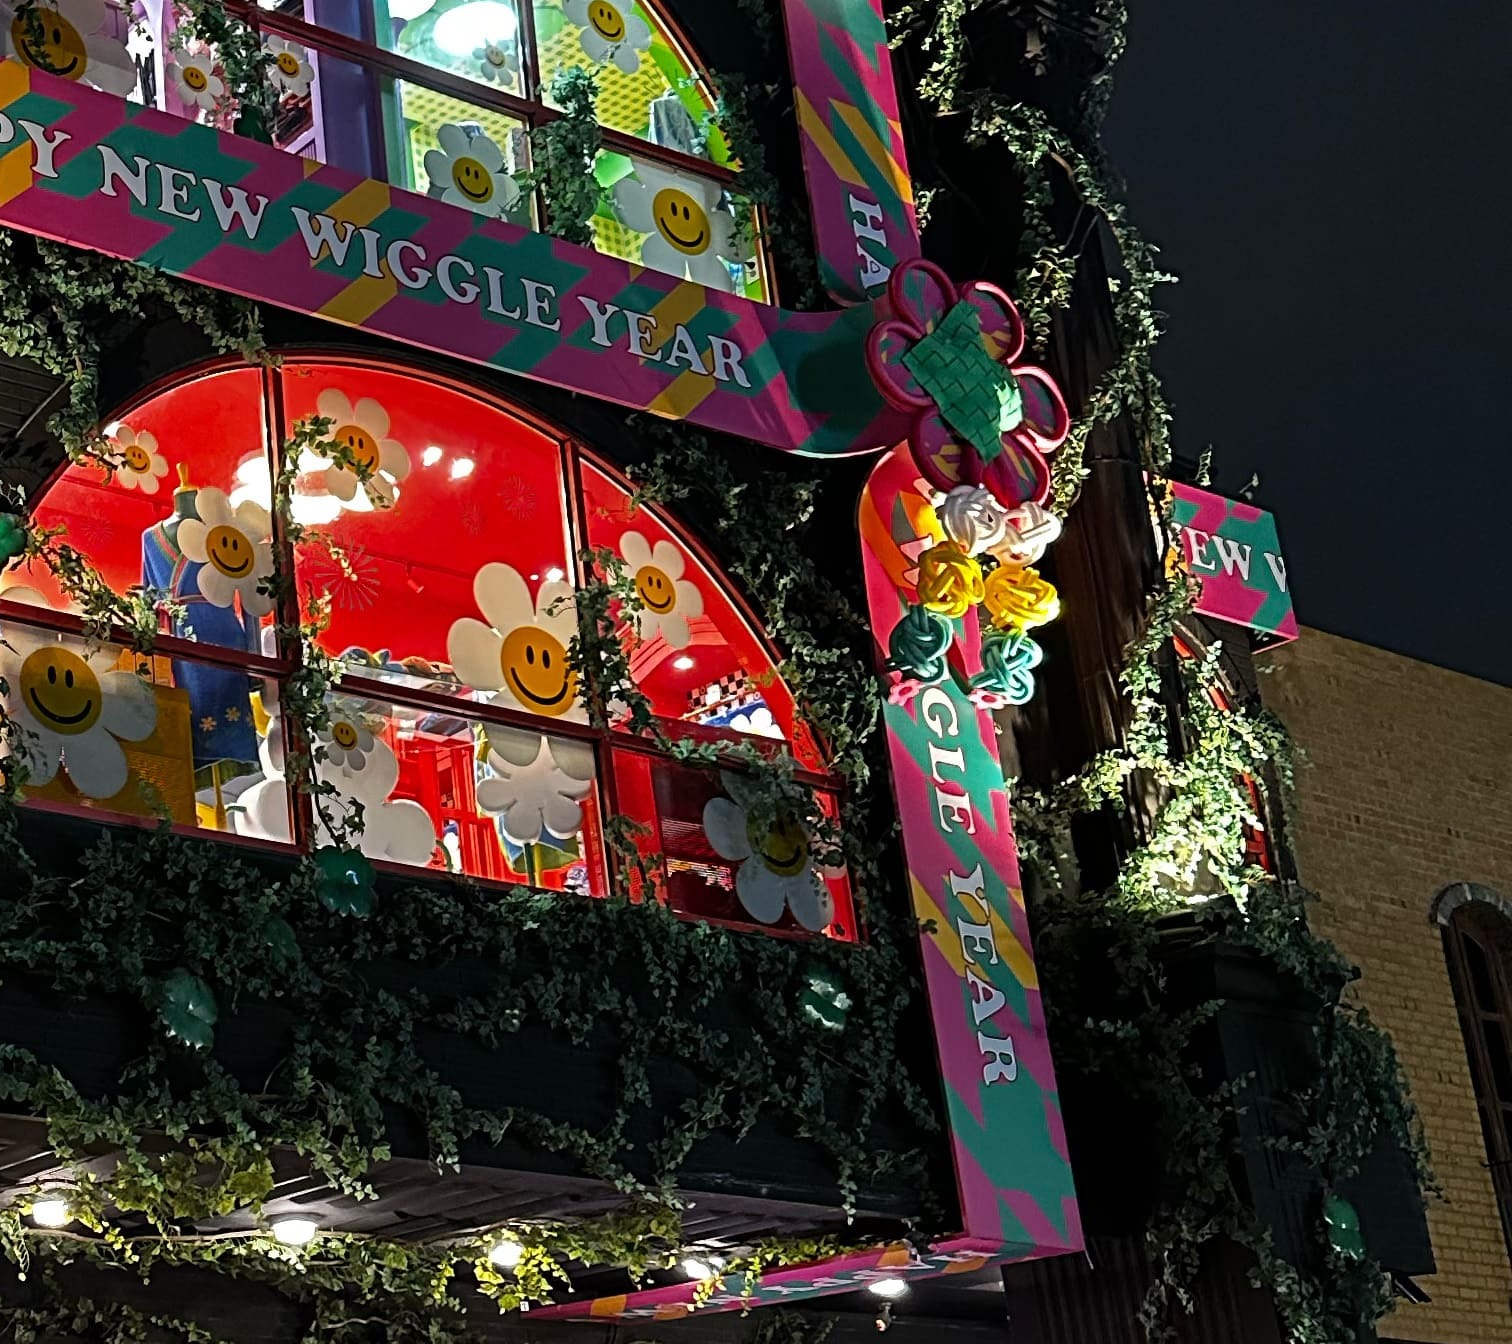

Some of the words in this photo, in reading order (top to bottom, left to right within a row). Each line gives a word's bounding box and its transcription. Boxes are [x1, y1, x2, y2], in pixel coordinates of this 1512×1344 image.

[96, 144, 268, 240] NEW
[291, 206, 561, 332] WIGGLE
[577, 295, 752, 388] YEAR
[921, 686, 976, 836] GLE
[950, 862, 1018, 1087] YEAR
